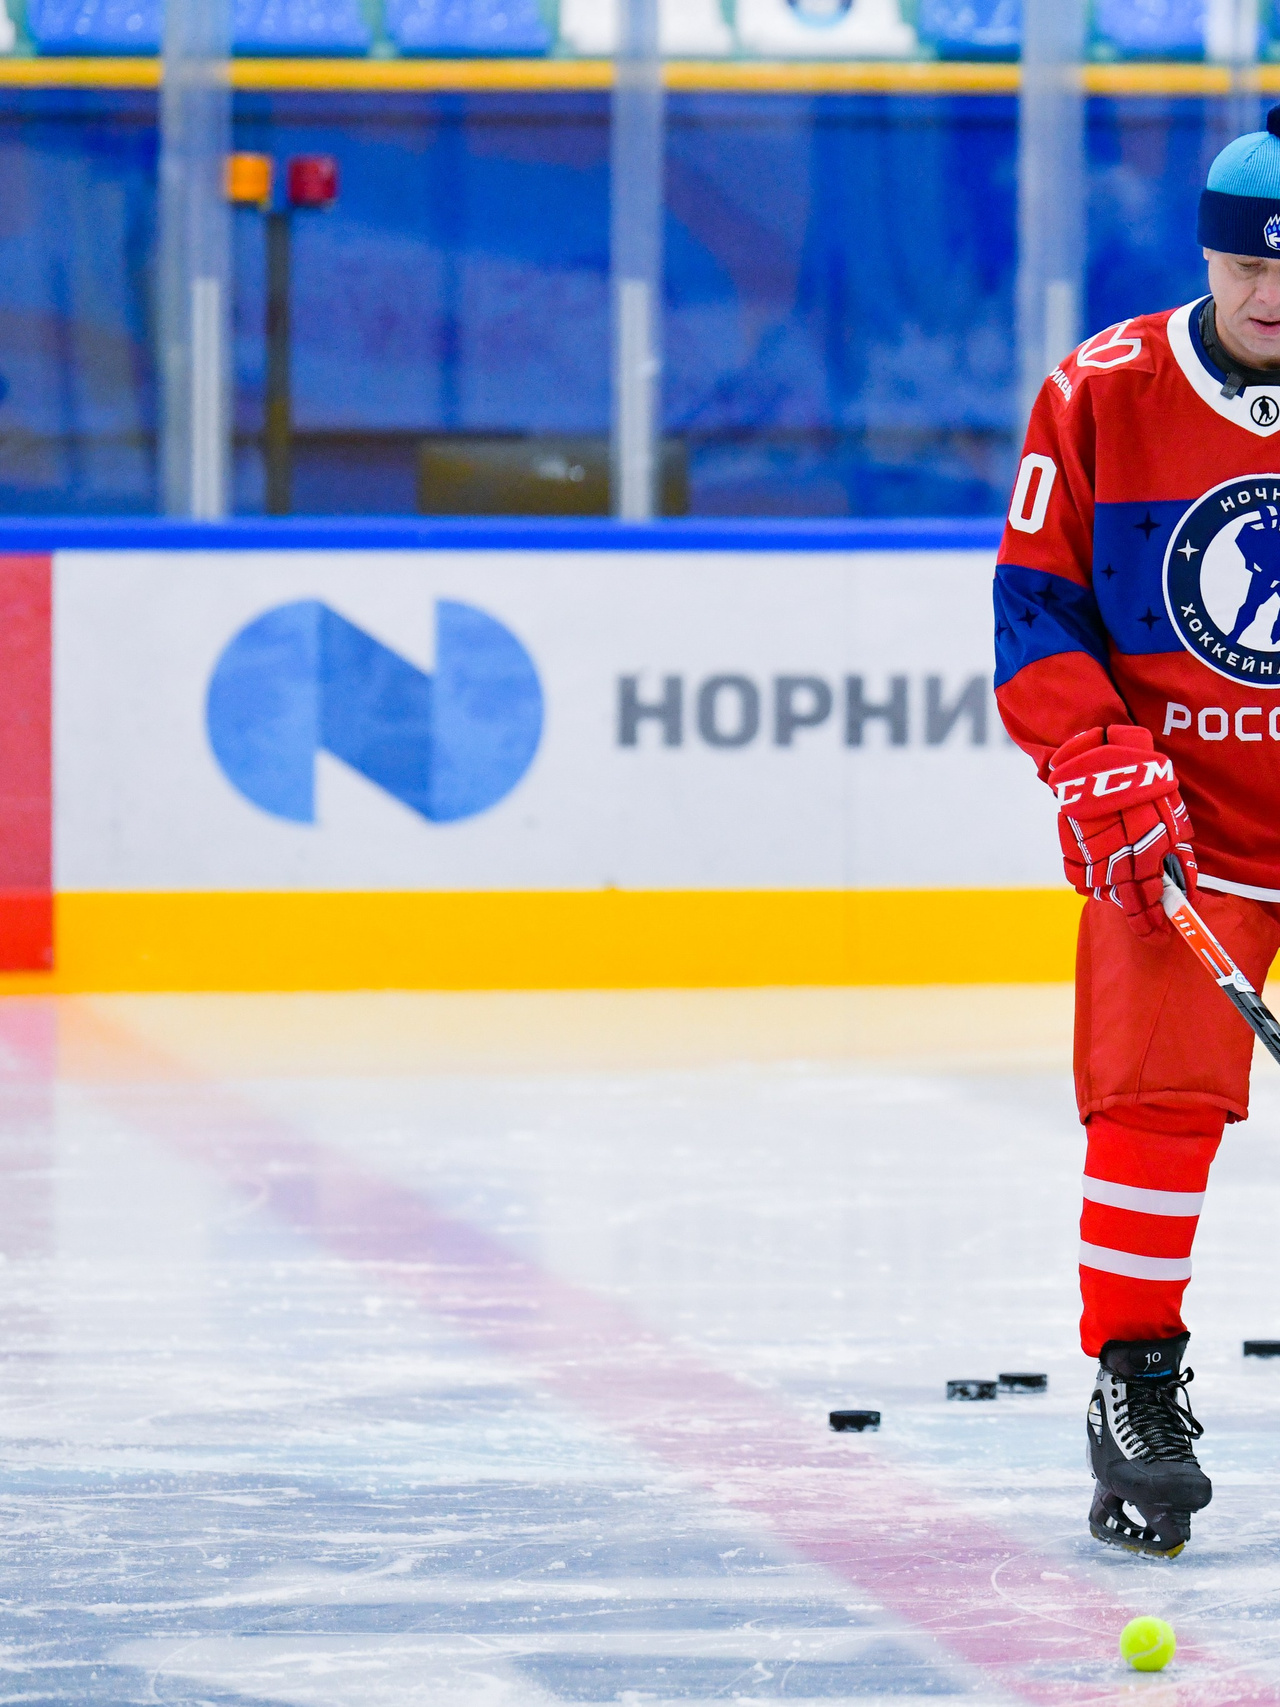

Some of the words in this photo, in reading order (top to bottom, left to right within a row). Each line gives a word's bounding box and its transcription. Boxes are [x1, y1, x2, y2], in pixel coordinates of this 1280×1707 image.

[1008, 452, 1057, 534] 0
[616, 673, 1015, 749] НОРНИ
[1055, 759, 1174, 806] CCM
[1144, 1351, 1162, 1365] 10
